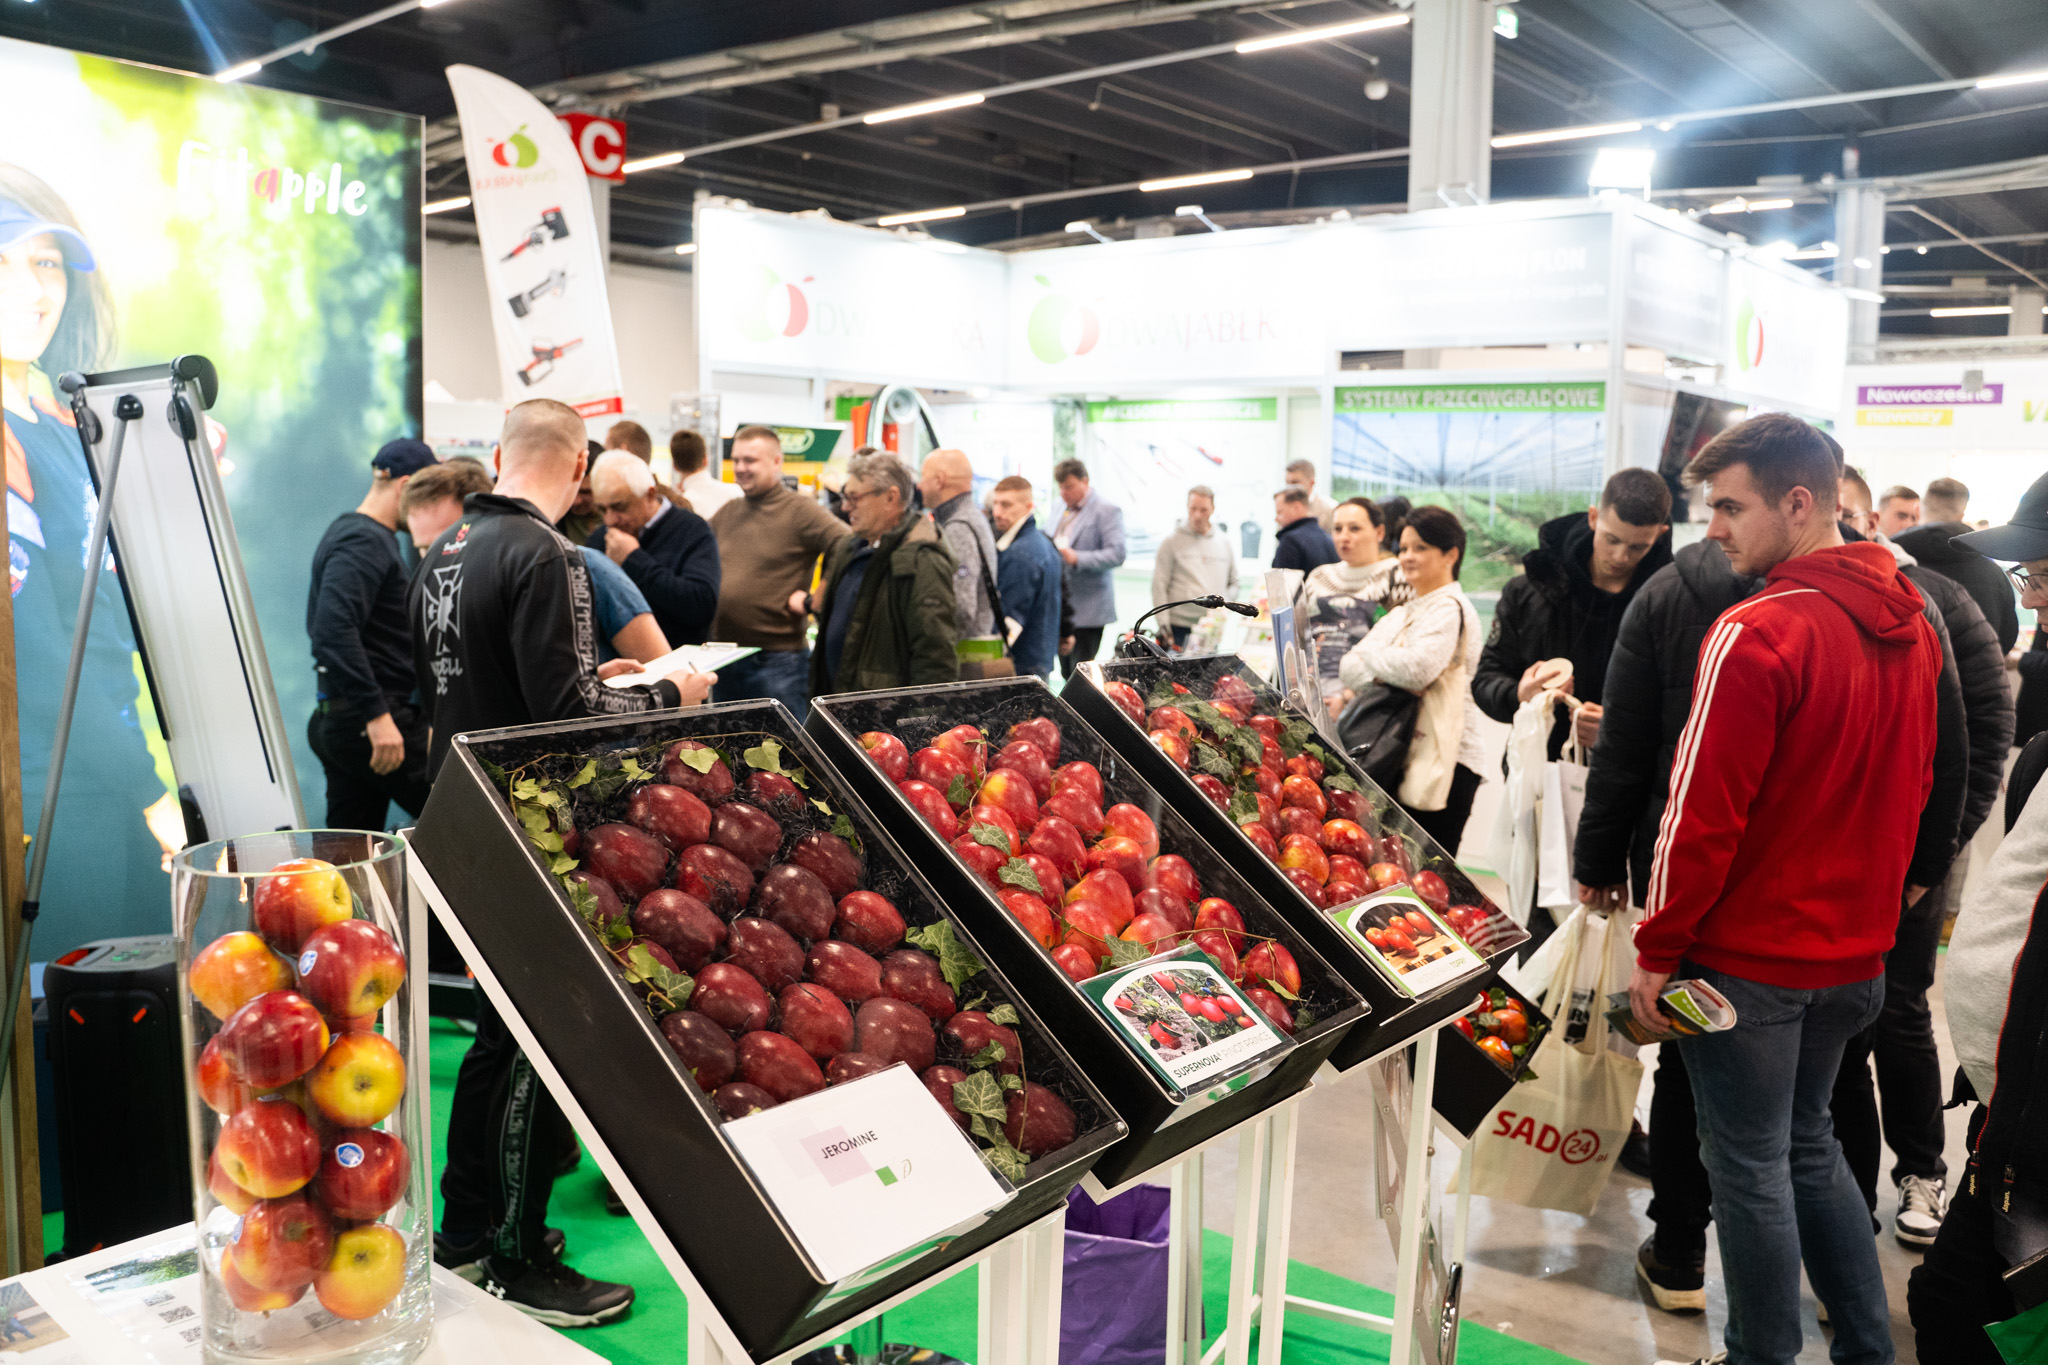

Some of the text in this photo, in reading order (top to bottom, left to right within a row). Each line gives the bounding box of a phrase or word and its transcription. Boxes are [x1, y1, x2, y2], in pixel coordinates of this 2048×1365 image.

[579, 120, 623, 176] C
[1106, 308, 1278, 352] DWAJABŁK
[1343, 387, 1600, 409] SYSTEMY PRZECIWGRADOWE
[1222, 1041, 1246, 1057] PINOT
[1244, 1031, 1272, 1048] PRINCE
[821, 1130, 879, 1159] JEROMINE
